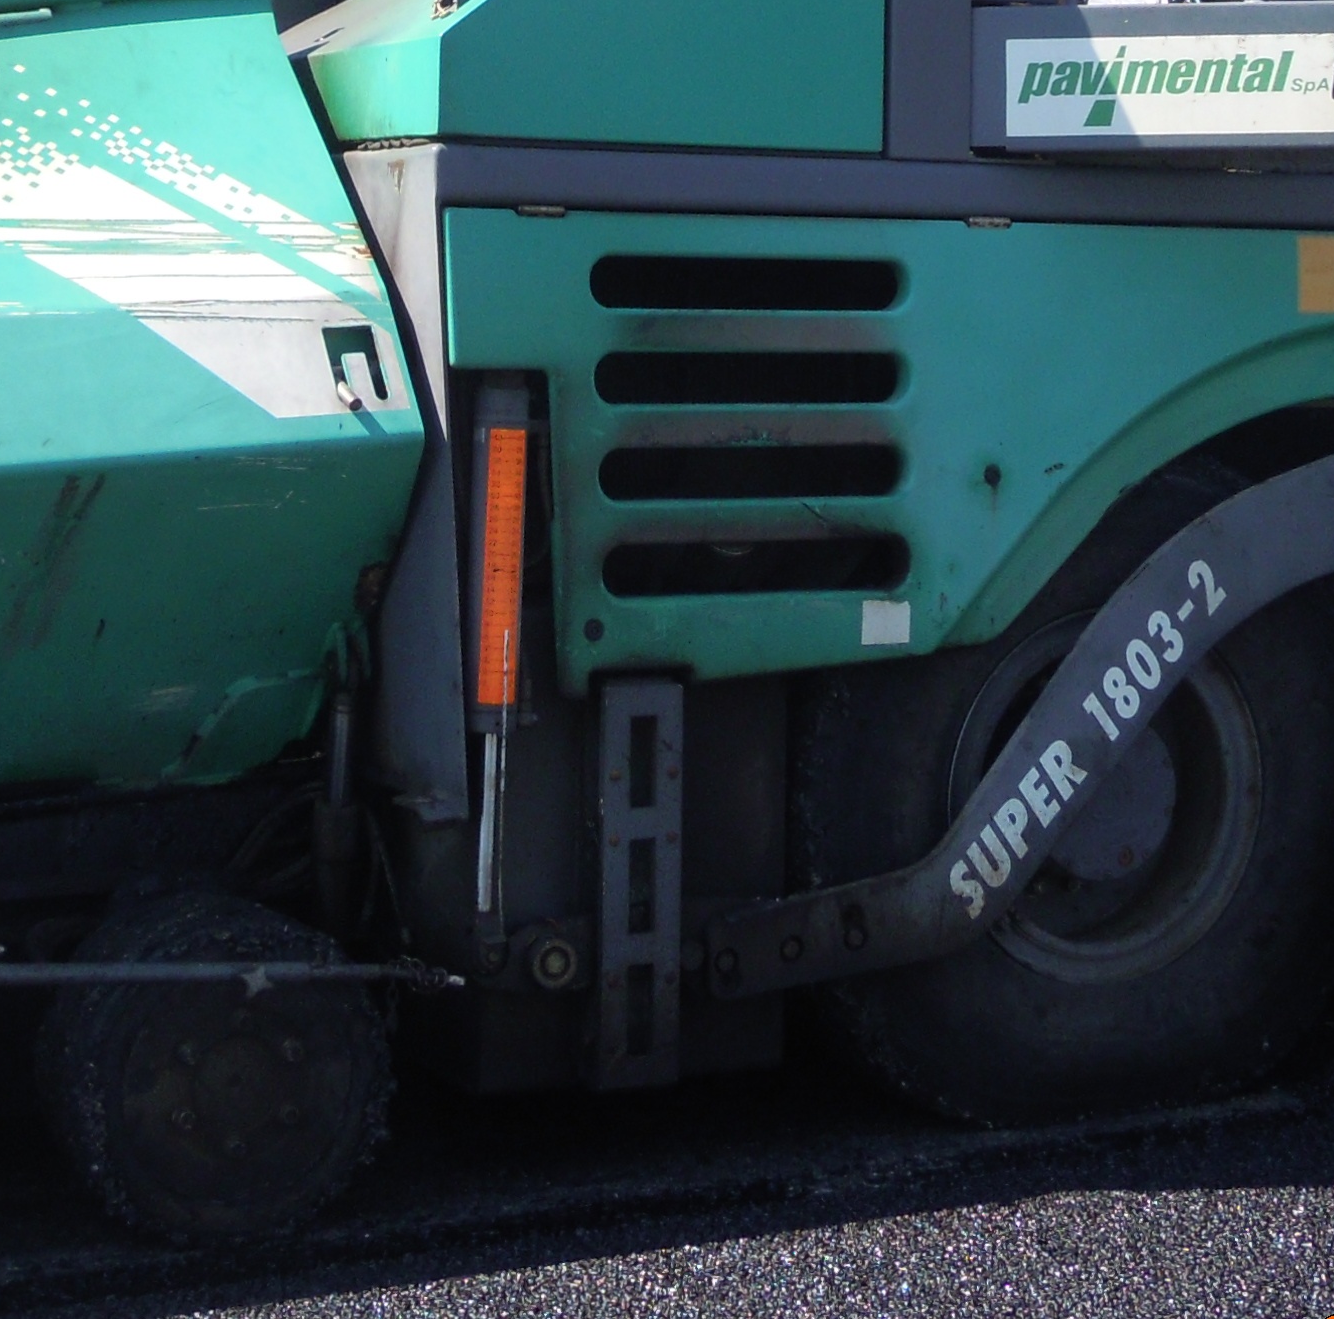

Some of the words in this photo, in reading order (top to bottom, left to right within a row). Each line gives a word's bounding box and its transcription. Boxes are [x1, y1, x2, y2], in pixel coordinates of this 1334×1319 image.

[1018, 46, 1295, 127] pavimental
[1290, 77, 1330, 95] SpA
[950, 739, 1088, 920] SUPER
[1082, 559, 1227, 742] 1803-2
